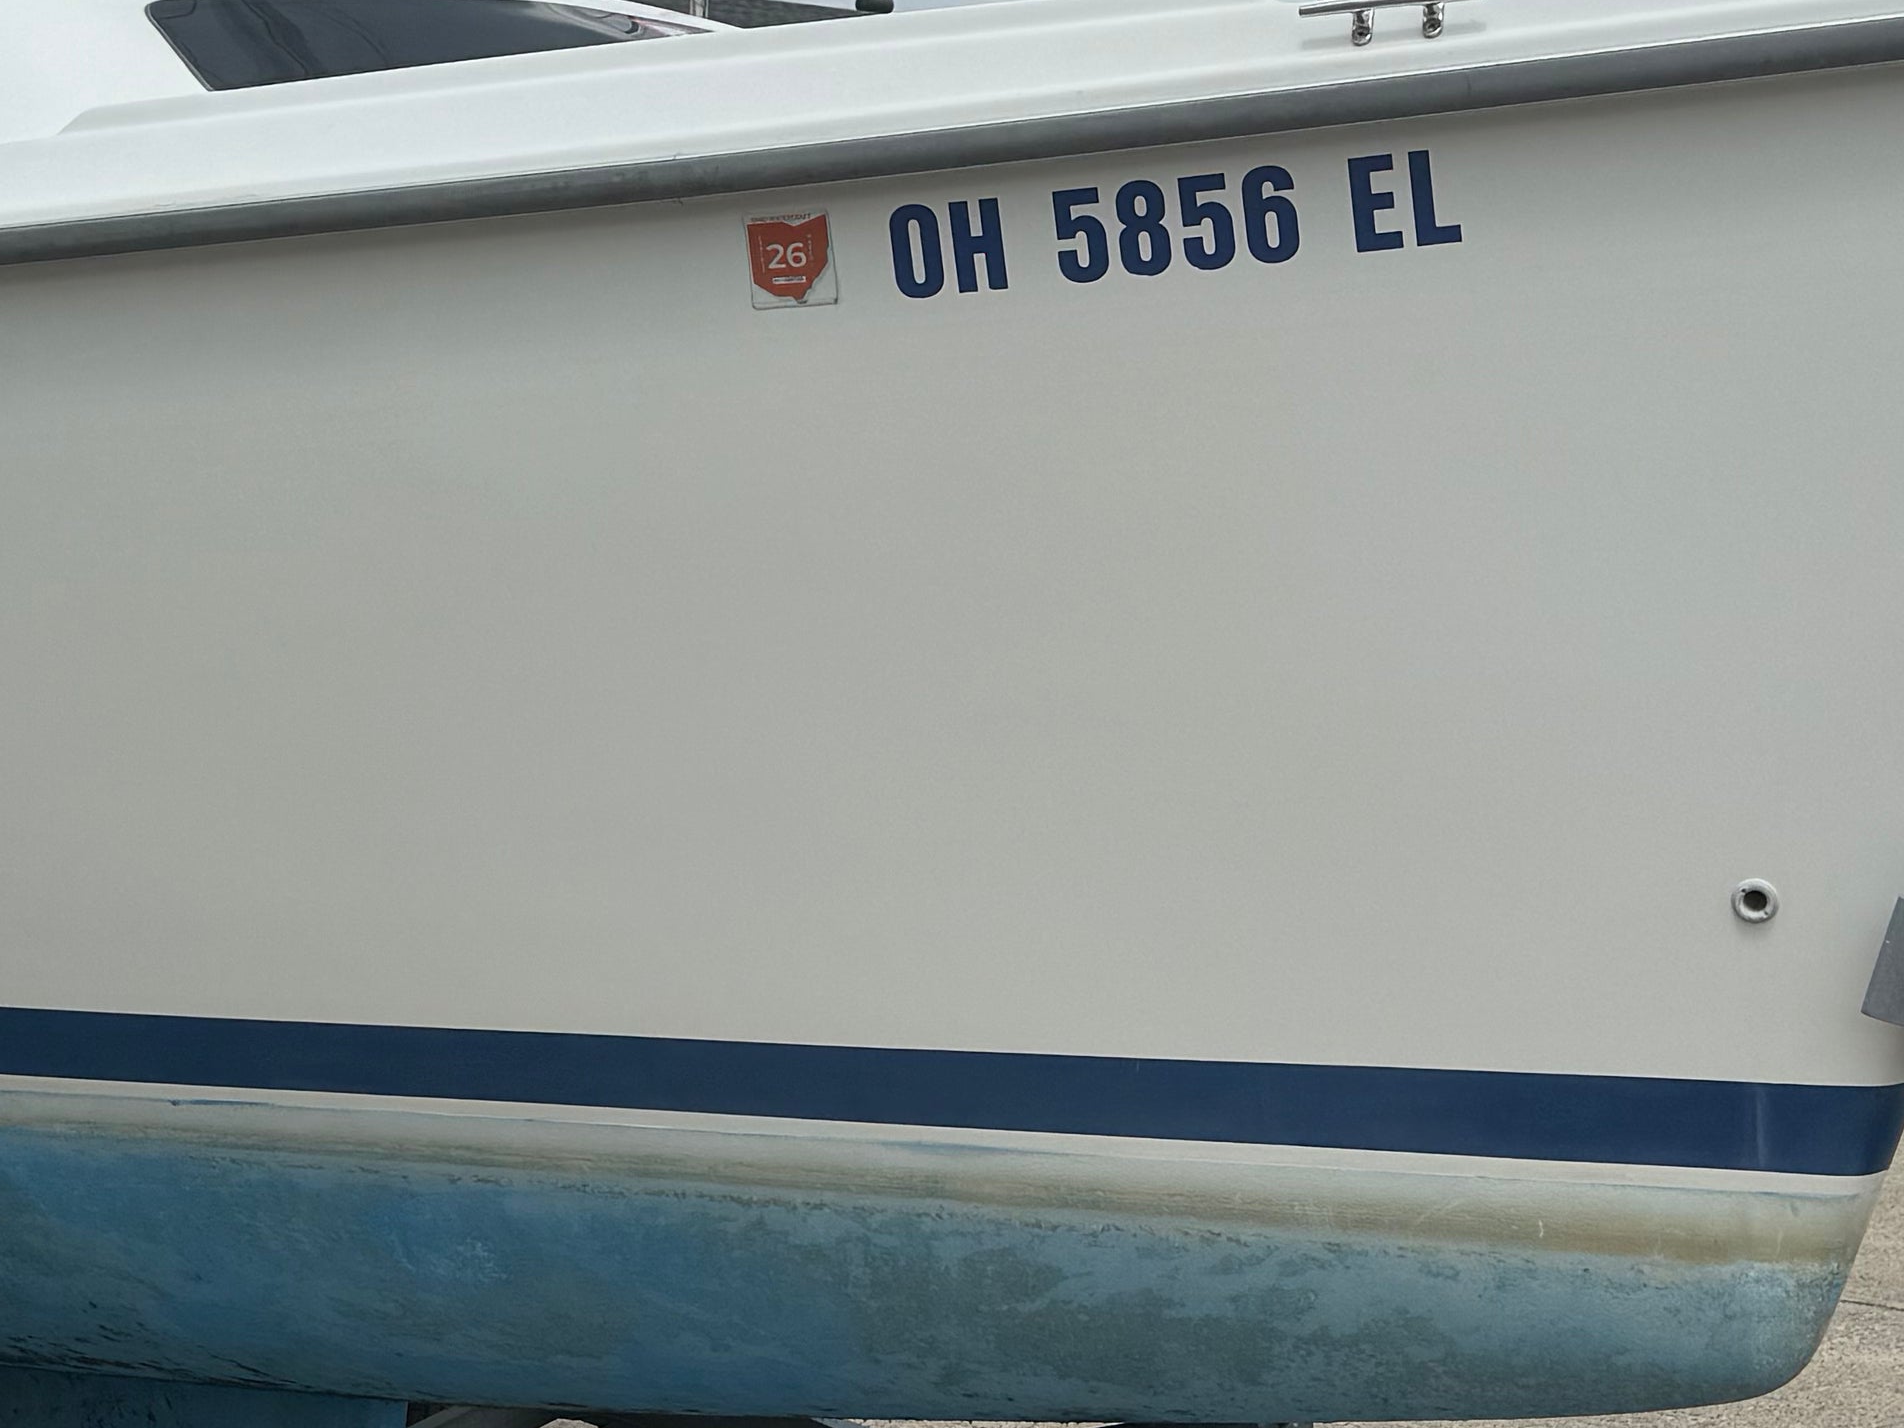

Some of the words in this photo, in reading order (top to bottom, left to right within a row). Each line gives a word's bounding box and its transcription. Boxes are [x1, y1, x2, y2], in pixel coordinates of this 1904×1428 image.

[765, 241, 808, 270] 26
[889, 197, 1009, 299] OH
[1051, 164, 1301, 284] 5856
[1347, 149, 1463, 254] EL
